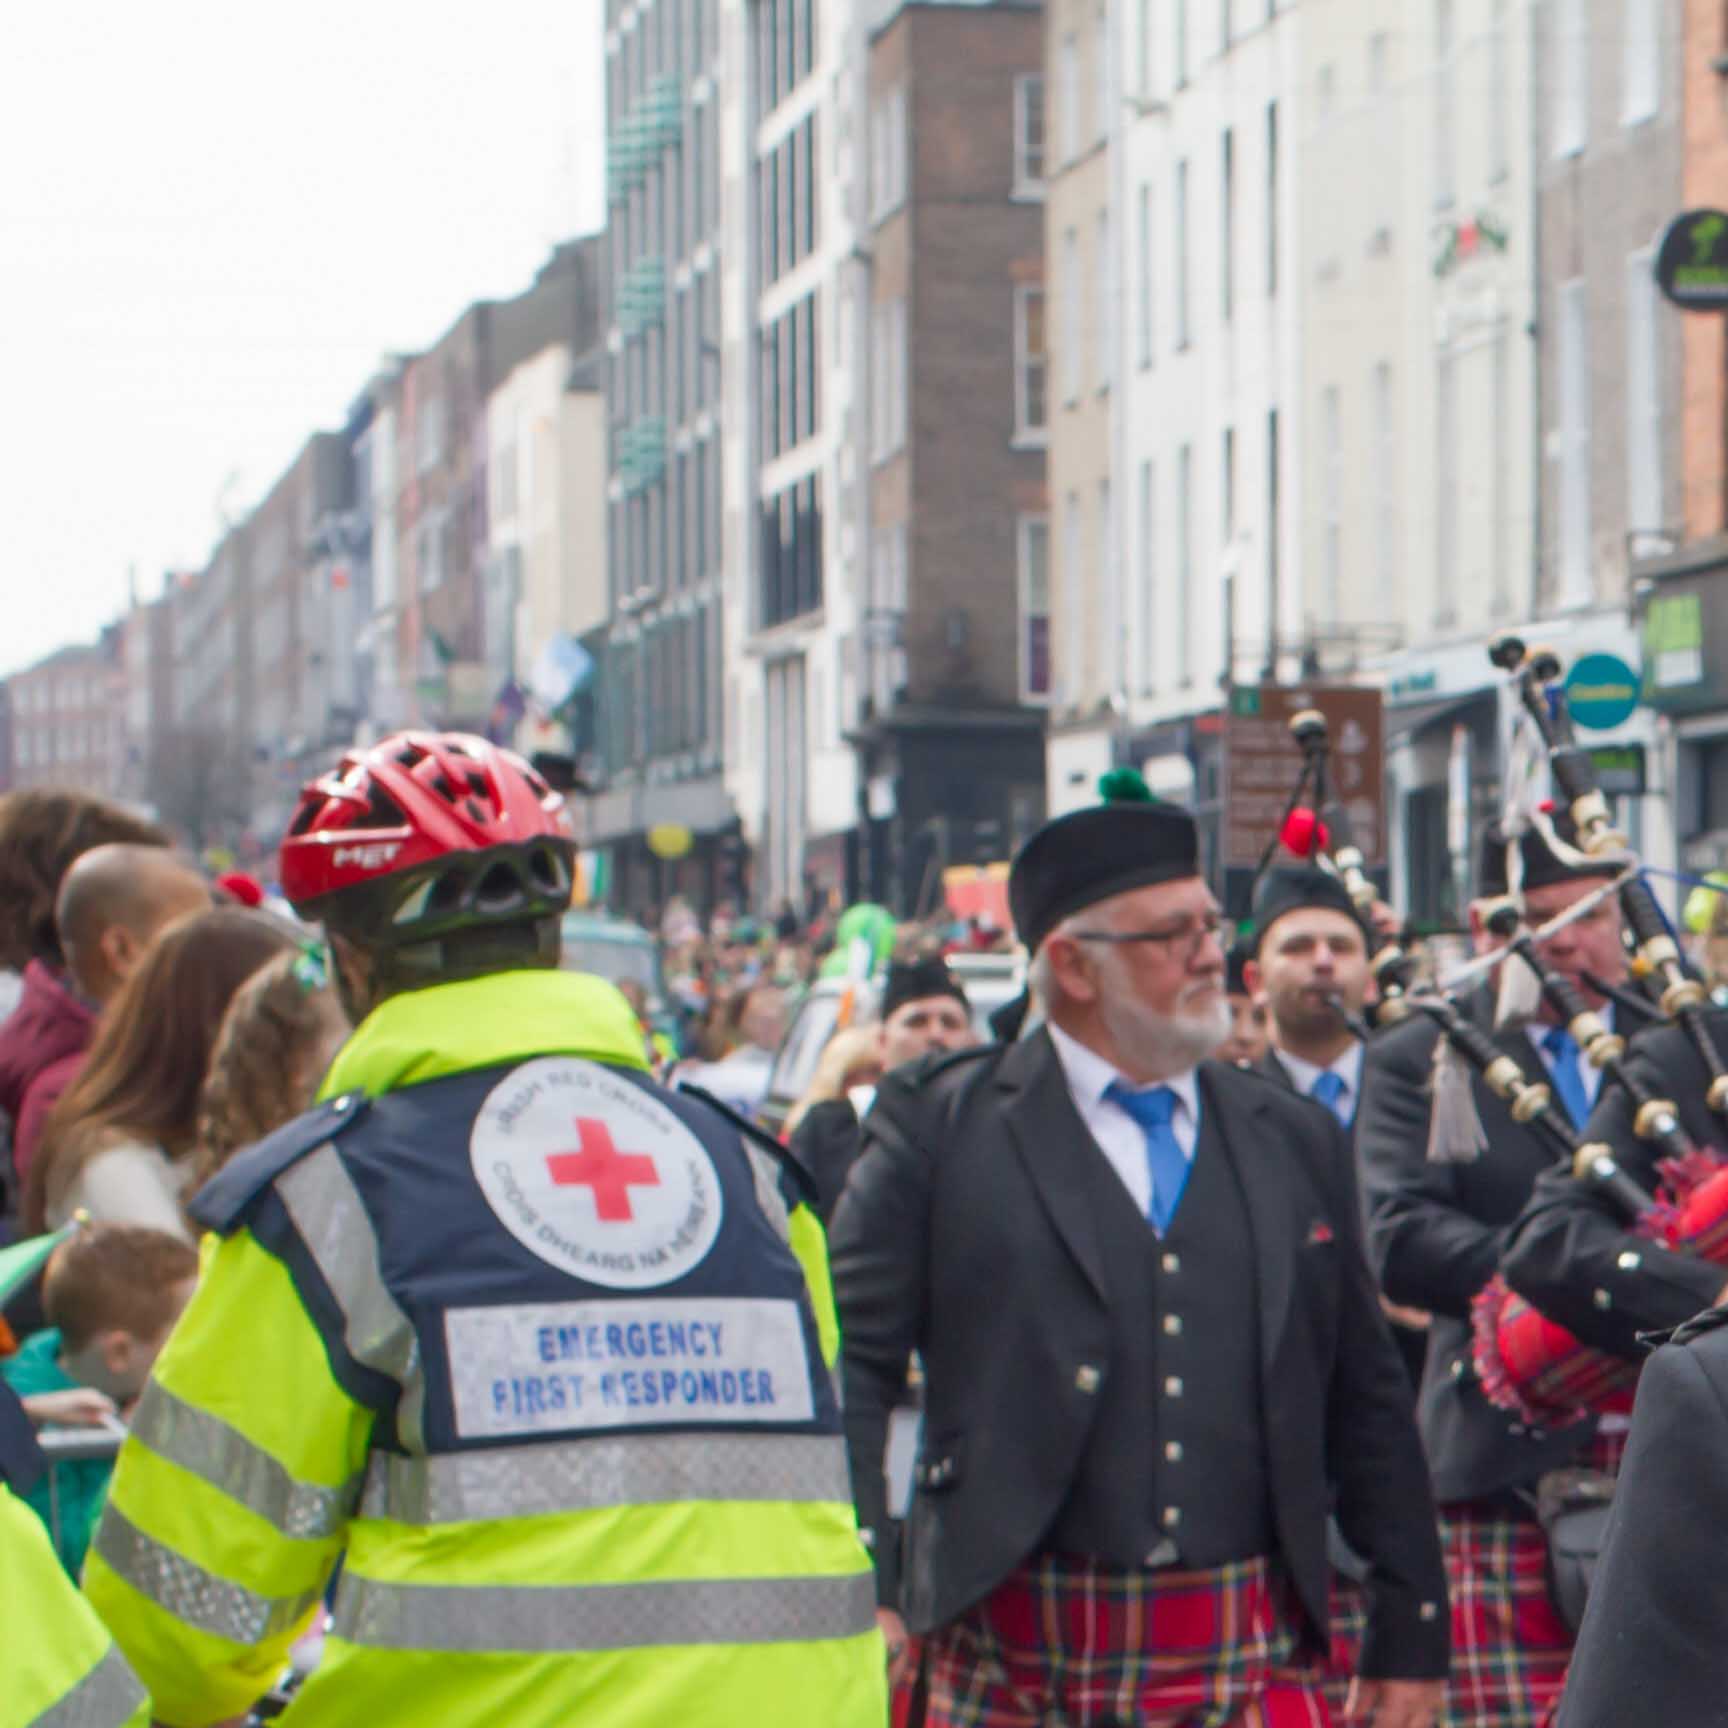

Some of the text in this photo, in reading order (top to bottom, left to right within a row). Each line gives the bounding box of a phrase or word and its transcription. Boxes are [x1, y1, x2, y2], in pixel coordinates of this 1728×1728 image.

[332, 843, 401, 868] MET
[548, 1070, 593, 1089] RED
[537, 1322, 723, 1362] EMERGENCY
[492, 1367, 776, 1415] FIRST RESPONDER
